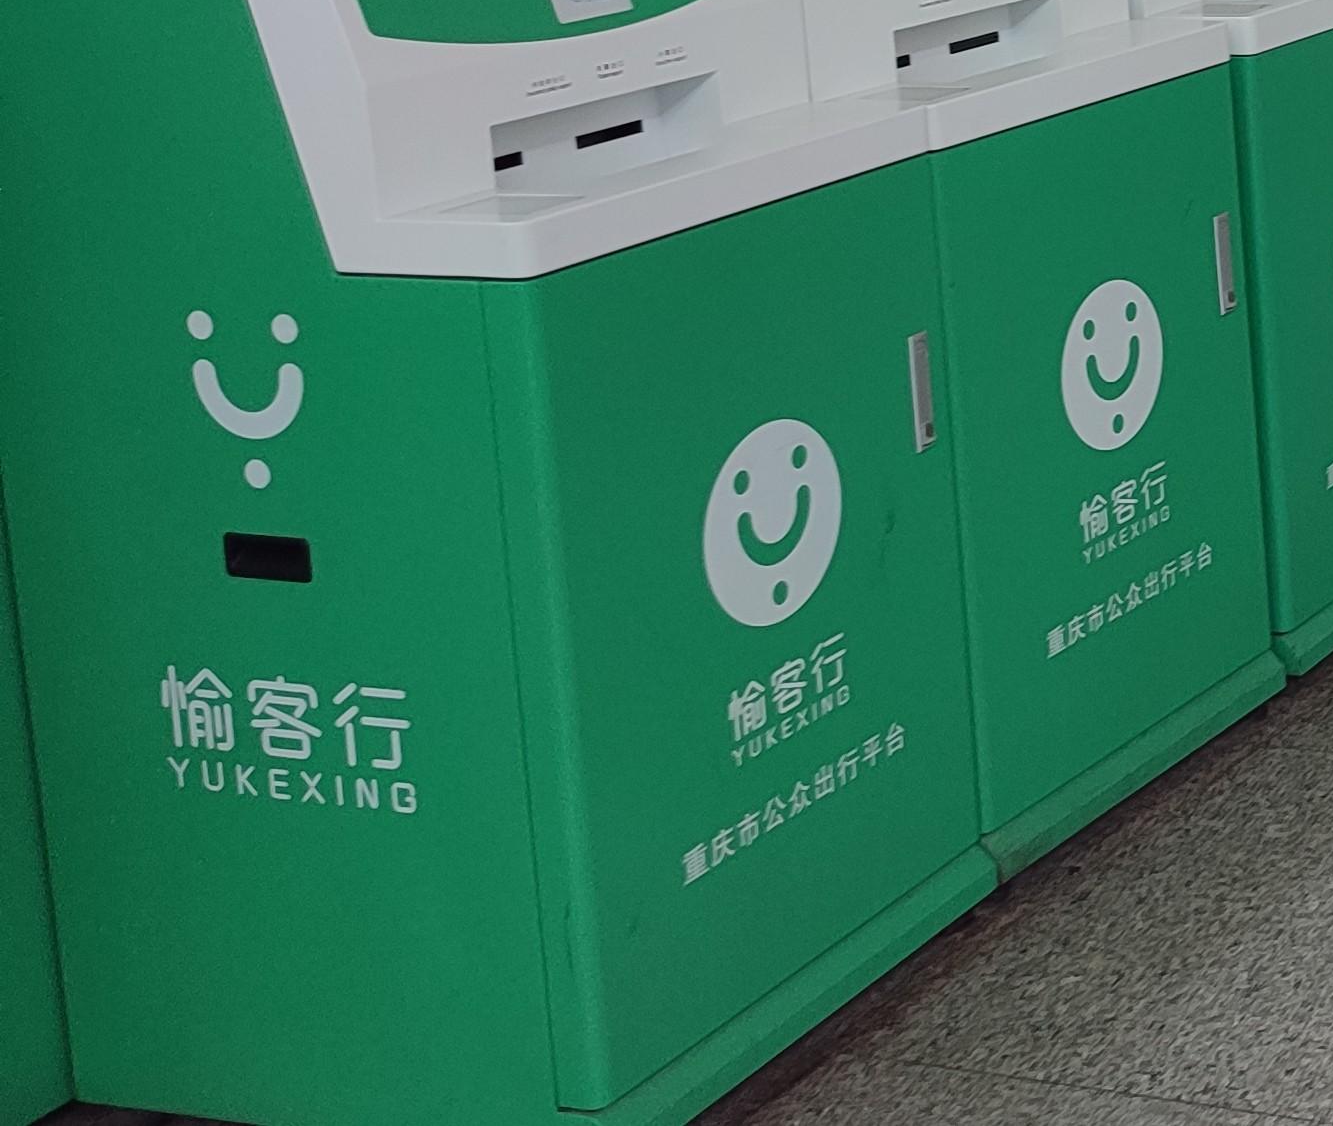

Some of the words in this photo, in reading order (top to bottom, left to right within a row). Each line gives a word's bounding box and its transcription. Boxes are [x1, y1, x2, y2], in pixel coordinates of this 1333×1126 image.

[1079, 460, 1168, 543] 愉客行
[1082, 506, 1171, 565] YUKEXING
[1047, 542, 1212, 660] 重庆市公众出行平台
[162, 665, 411, 771] 愉客行
[727, 632, 847, 741] 愉客行
[731, 684, 851, 767] YUKEXING
[167, 756, 418, 814] YUKEXING
[682, 722, 905, 887] 重庆市公众出行平台
